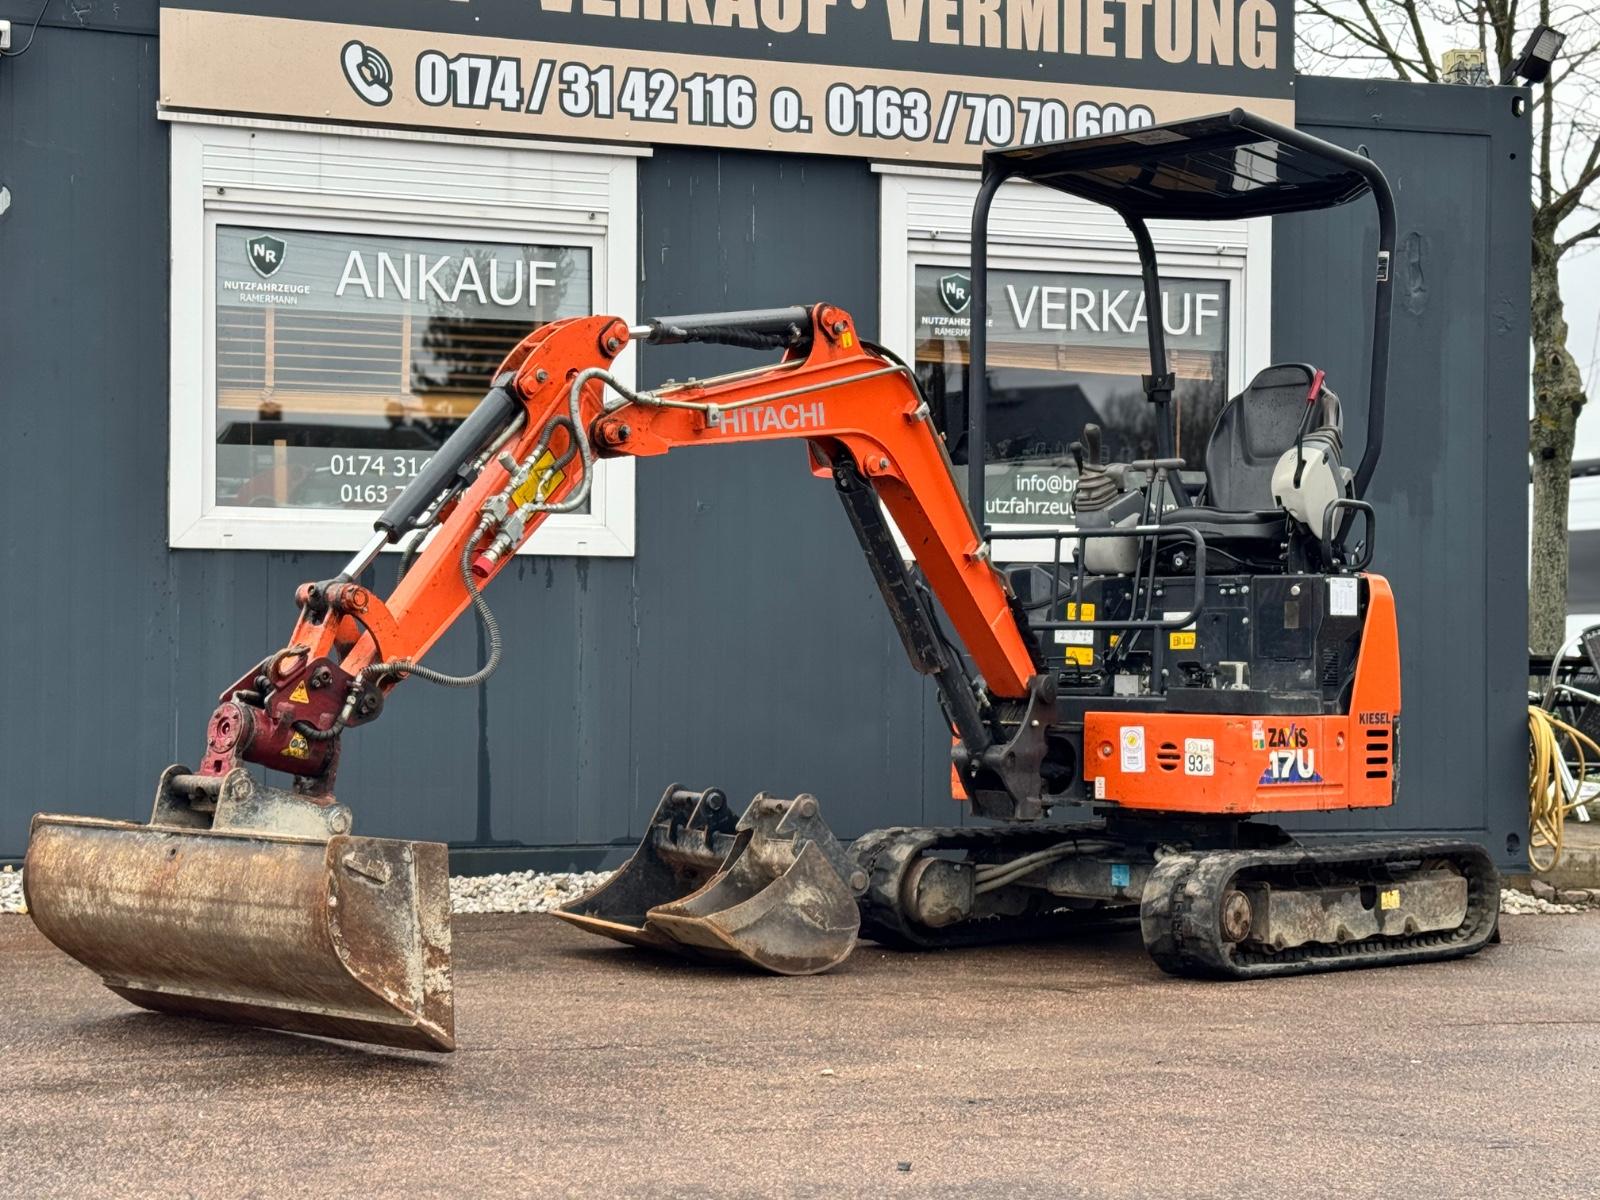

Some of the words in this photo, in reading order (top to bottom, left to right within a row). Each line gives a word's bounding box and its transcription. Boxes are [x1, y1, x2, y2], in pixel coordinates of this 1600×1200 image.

[886, 0, 1277, 70] VERMIETUNG
[416, 49, 524, 112] 0174
[770, 86, 813, 133] o.
[826, 82, 932, 142] 0163
[224, 281, 310, 294] NUTZFAHRZEUGE
[336, 250, 557, 307] ANKAUF
[240, 293, 297, 304] RAMERMANN
[1007, 284, 1219, 335] VERKAUF
[922, 316, 993, 327] NUTZFAHRZE
[720, 402, 825, 434] HITACHI
[330, 455, 385, 476] 0174
[340, 484, 387, 503] 0163
[1359, 713, 1391, 724] KIESEL
[1188, 755, 1203, 772] 93
[1269, 749, 1315, 779] 17U
